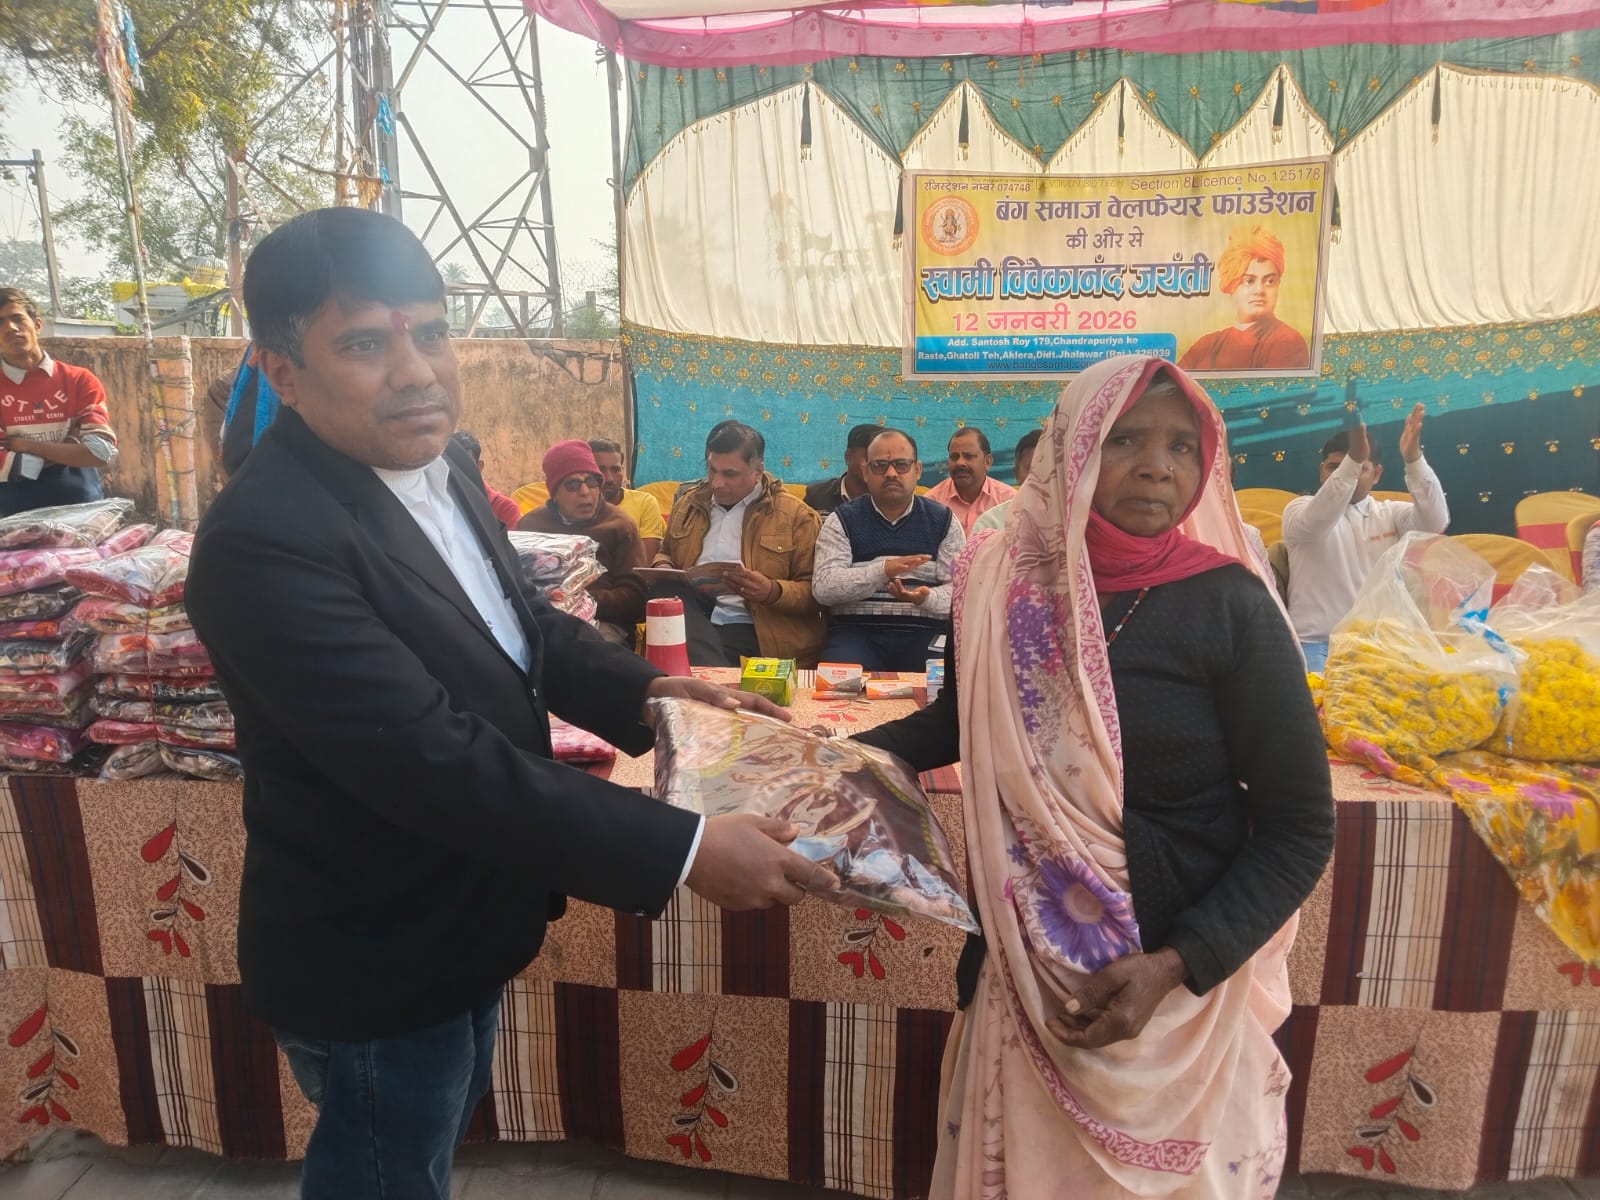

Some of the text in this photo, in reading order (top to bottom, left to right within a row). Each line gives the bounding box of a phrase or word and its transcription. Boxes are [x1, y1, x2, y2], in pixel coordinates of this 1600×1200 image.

[997, 183, 1031, 192] 074748
[1130, 178, 1179, 190] Section
[996, 194, 1030, 221] बंग
[1035, 200, 1103, 222] समाज
[1108, 194, 1206, 219] वेलफेयर
[1066, 226, 1144, 249] की और से
[921, 256, 997, 303] स्वामी
[952, 302, 1137, 332] 12 जनवरी 2026
[948, 338, 968, 347] Add.
[971, 337, 1010, 347] Santosh
[1012, 337, 1030, 348] Roy
